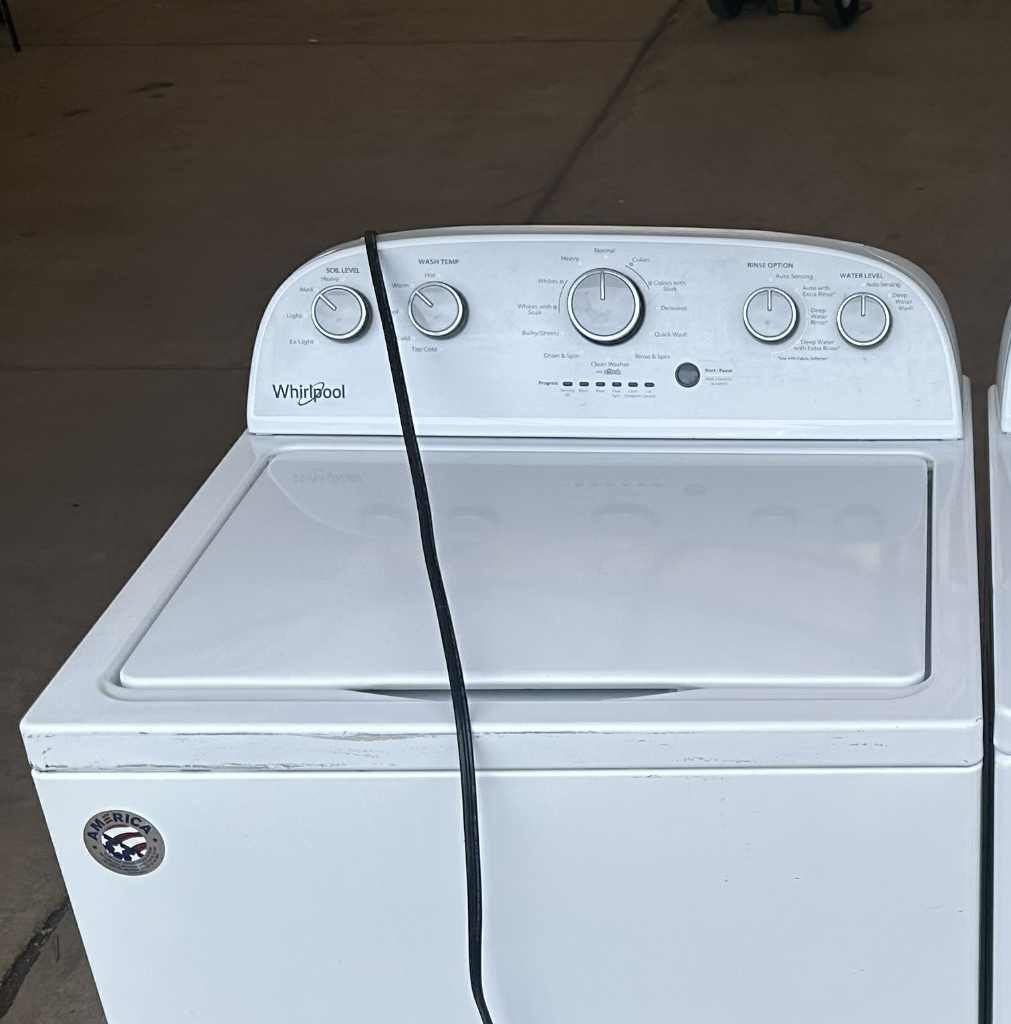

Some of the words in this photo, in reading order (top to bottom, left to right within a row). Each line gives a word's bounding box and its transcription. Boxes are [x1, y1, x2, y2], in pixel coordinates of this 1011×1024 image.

[790, 273, 814, 281] Sensing
[286, 312, 303, 321] Light
[272, 382, 345, 406] Whirlpool
[88, 813, 151, 841] AMERICA
